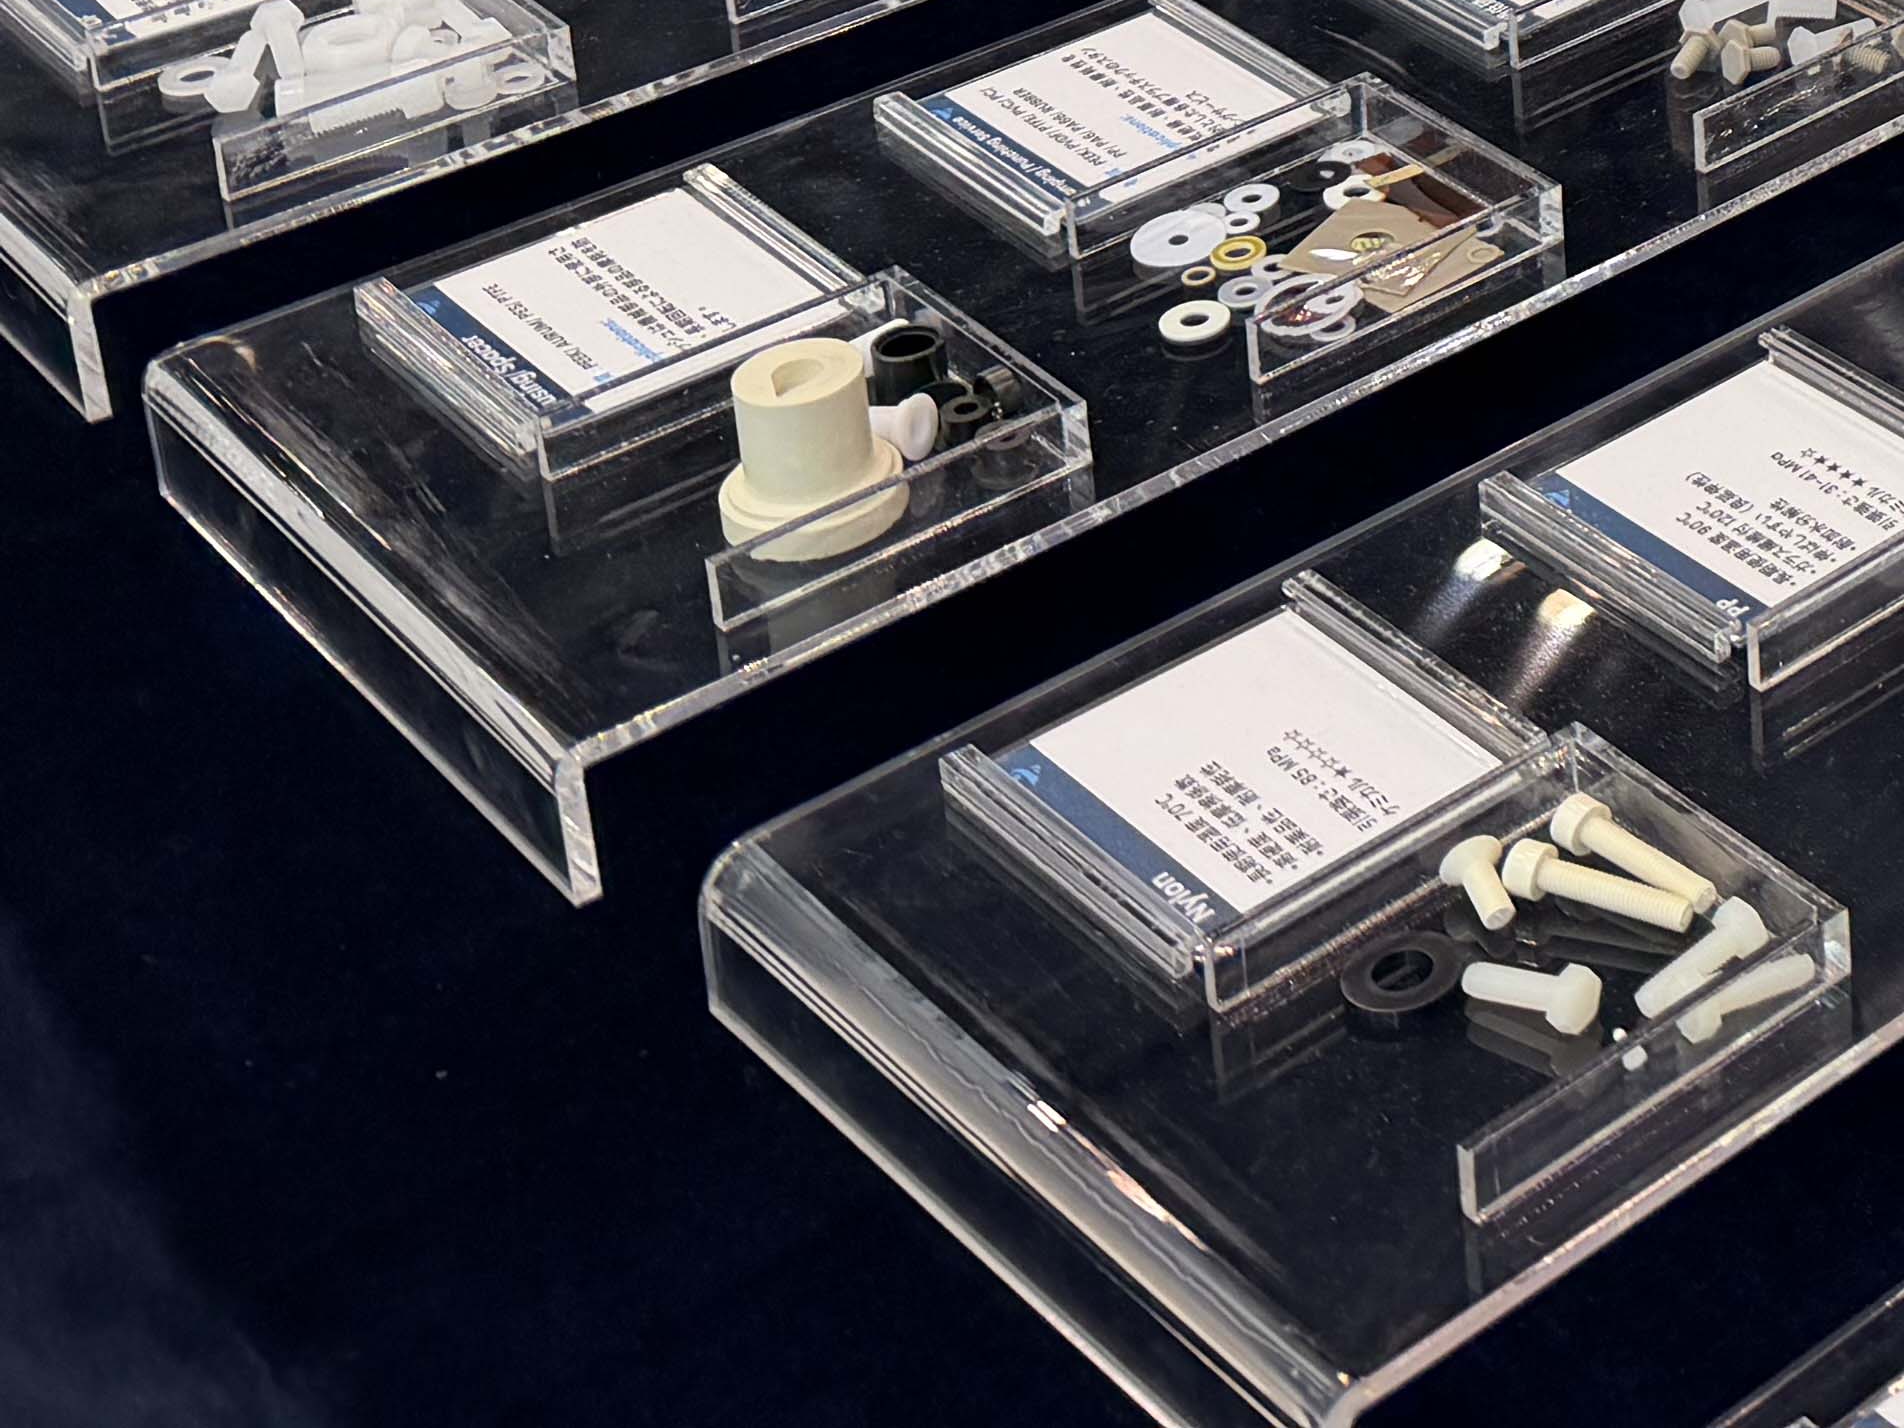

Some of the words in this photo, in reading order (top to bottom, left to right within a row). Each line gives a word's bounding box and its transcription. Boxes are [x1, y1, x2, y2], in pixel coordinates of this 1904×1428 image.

[481, 283, 513, 304] PTFE
[454, 334, 517, 375] Spacer
[563, 347, 598, 370] PEEK/
[1770, 451, 1803, 473] MPa
[1707, 531, 1794, 585] 長期使用温度
[1710, 598, 1750, 619] PP
[1266, 746, 1299, 772] MPa
[1290, 767, 1318, 786] 85
[1347, 777, 1400, 816] ケミカル
[1184, 815, 1272, 883] 長期使用温度
[1140, 871, 1216, 928] Nylon
